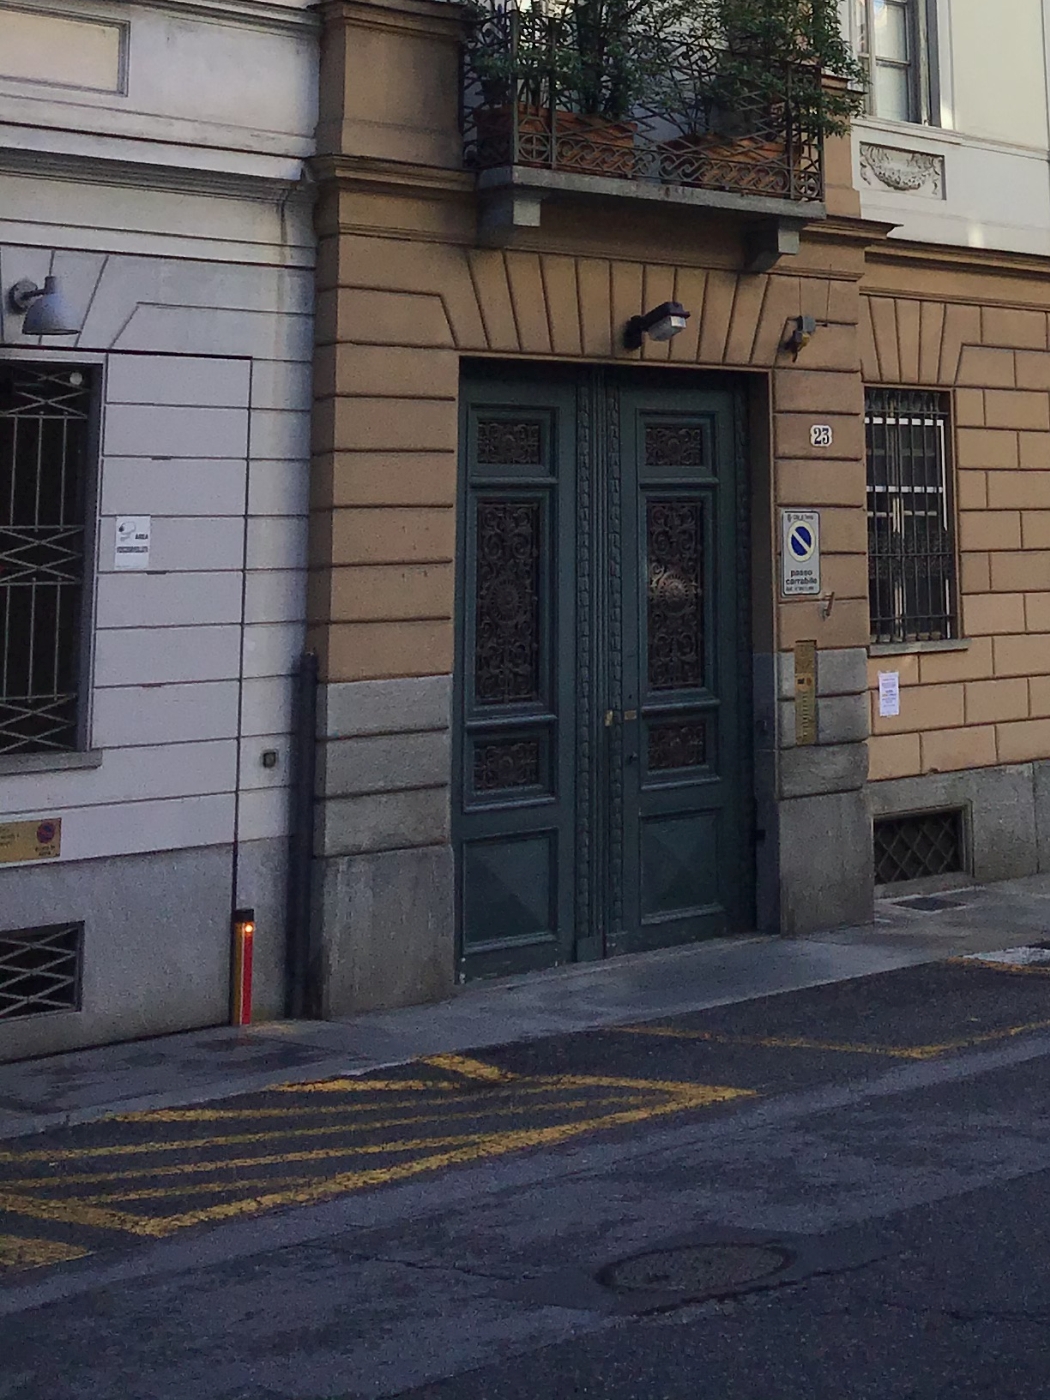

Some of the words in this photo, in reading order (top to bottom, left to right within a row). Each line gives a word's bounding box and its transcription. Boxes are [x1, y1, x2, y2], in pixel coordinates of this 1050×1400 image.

[813, 427, 830, 445] 23
[790, 569, 813, 577] passo
[785, 577, 818, 585] carrabile
